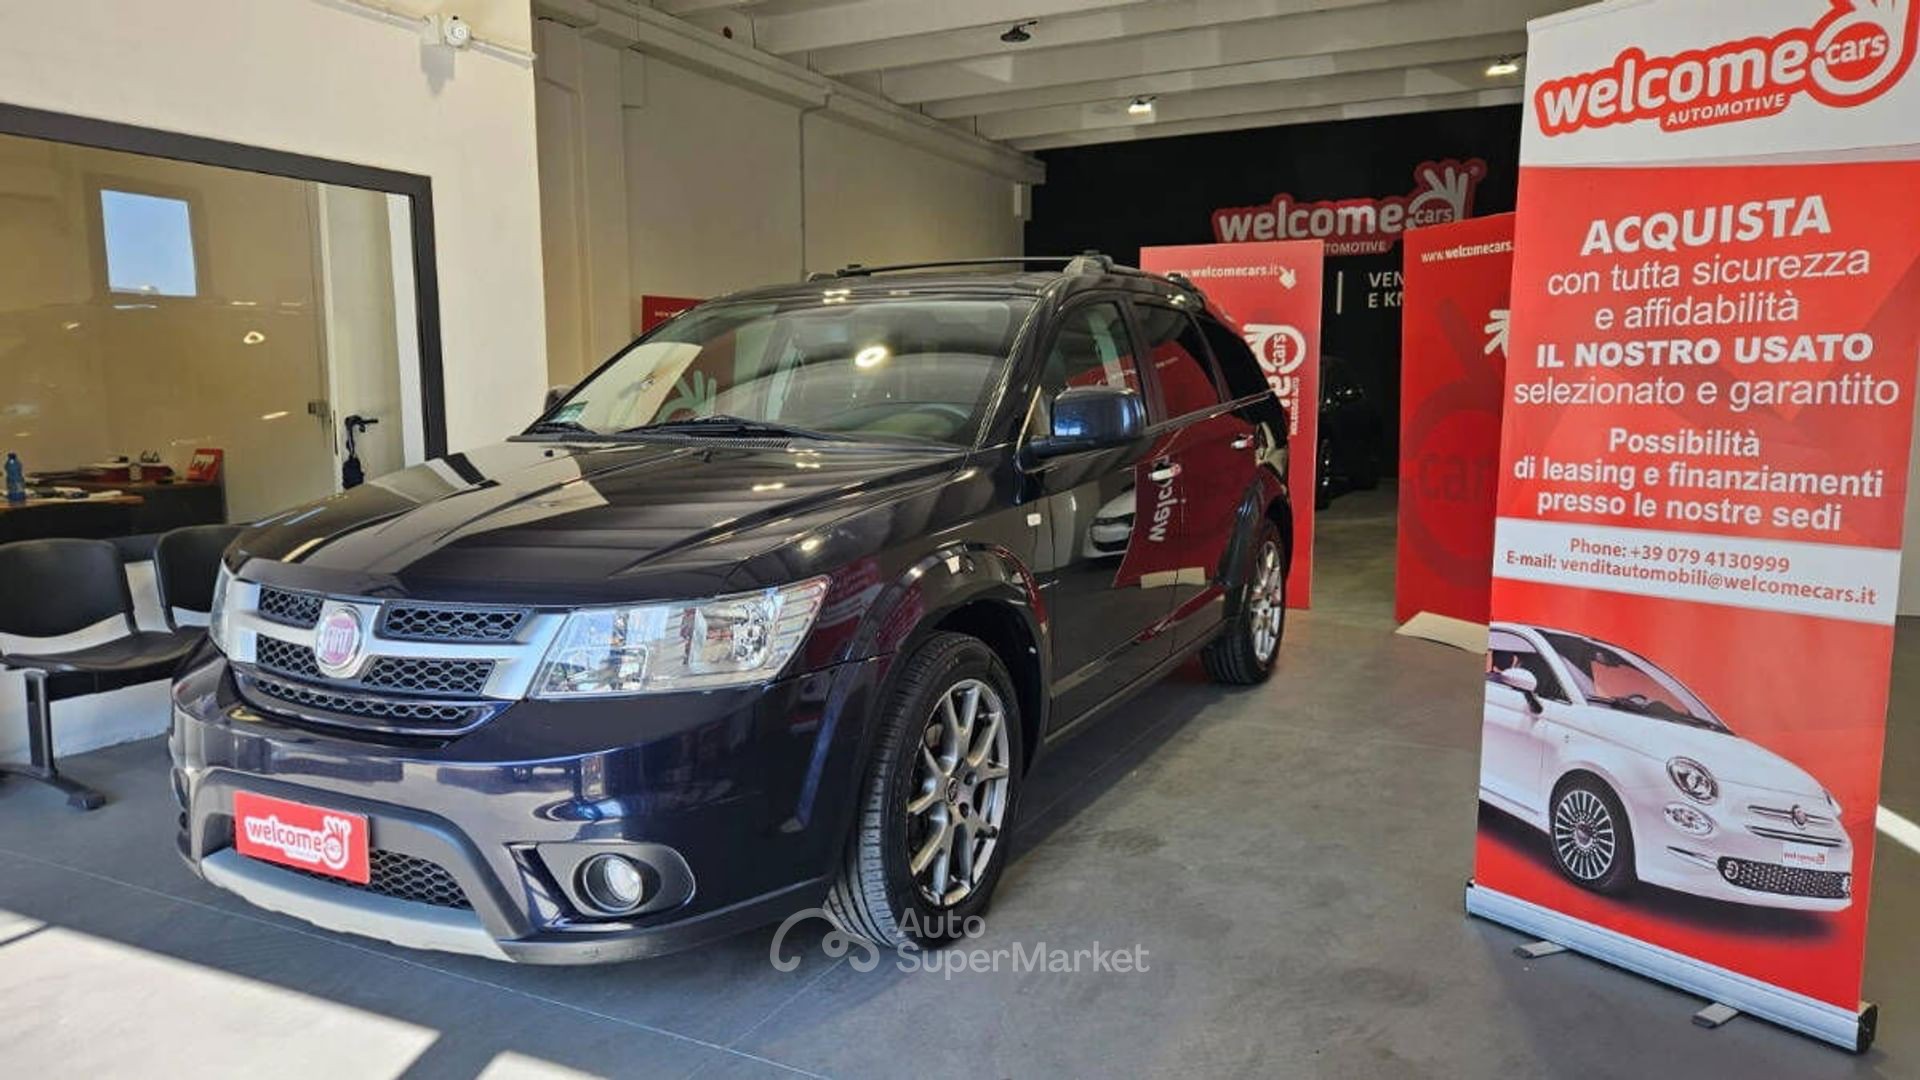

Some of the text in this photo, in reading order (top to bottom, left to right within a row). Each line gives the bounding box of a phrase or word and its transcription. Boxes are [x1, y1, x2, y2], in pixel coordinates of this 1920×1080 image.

[1543, 32, 1888, 127] welcome cars
[1666, 94, 1786, 127] AUTOMOTIVE
[1218, 201, 1454, 241] welcome cars
[1580, 195, 1831, 256] ACQUISTA
[1326, 240, 1386, 254] TOMOTIVE
[1421, 241, 1513, 263] www.welcomecars.
[1165, 264, 1278, 278] w.welcomecars.it
[1369, 271, 1405, 287] VEN
[1548, 249, 1871, 296] con tutta sicurezza
[1368, 292, 1379, 308] E
[1595, 291, 1799, 330] e affidabilità
[1273, 334, 1287, 366] cars
[1536, 333, 1874, 368] IL NOSTRO USATO
[1514, 373, 1900, 411] selezionato e garantito
[1608, 427, 1760, 458] Possibilità
[1419, 452, 1494, 502] car
[1514, 456, 1883, 498] di leasing e finanziamenti
[1537, 490, 1843, 532] presso le nostre sedi
[1570, 538, 1790, 573] Phone: +39 079 4130999
[1506, 550, 1877, 605] E-mail: venditautomobili@welcomecars.it
[248, 821, 322, 851] welcome
